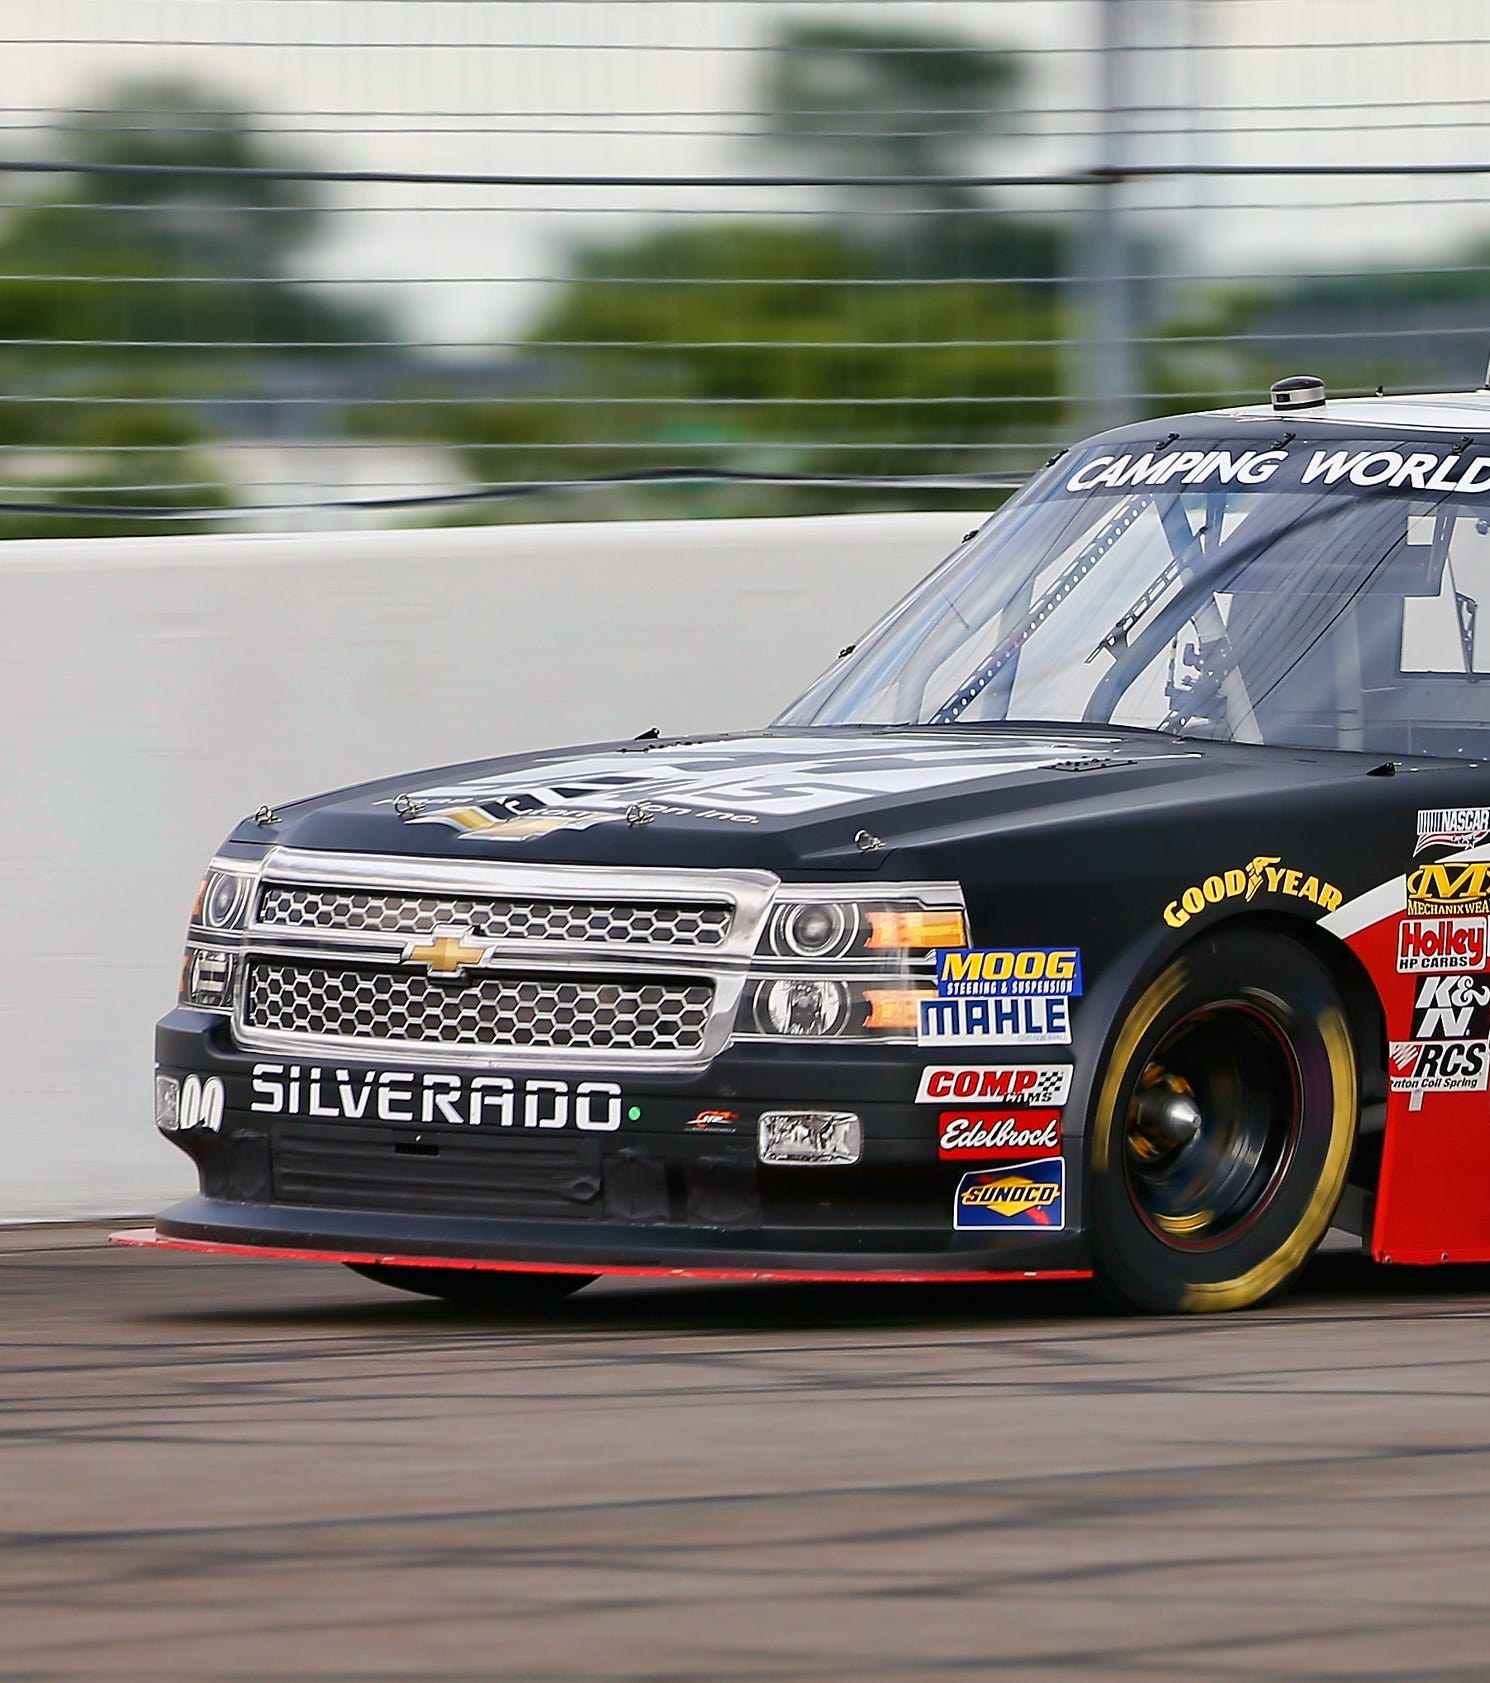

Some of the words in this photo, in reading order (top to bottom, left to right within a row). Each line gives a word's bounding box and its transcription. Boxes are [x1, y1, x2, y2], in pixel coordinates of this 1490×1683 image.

[1065, 450, 1287, 492] CAMPING
[1440, 809, 1490, 833] NASCAR
[1163, 856, 1344, 928] GOODYEAR
[1407, 899, 1464, 916] MECHANIX
[1401, 921, 1485, 966] Holley
[941, 951, 1077, 981] MOOG
[1399, 957, 1418, 970] HP
[1420, 955, 1468, 968] CARBS
[946, 981, 997, 995] STEERING
[1000, 981, 1008, 994] &
[1011, 979, 1073, 994] SUSPENSION
[921, 999, 1066, 1036] MAHLE
[1413, 1042, 1487, 1077] RCS
[250, 1064, 622, 1131] SILVERADO
[927, 1070, 1038, 1098] COMP
[1001, 1091, 1053, 1104] CAMS
[1421, 1078, 1441, 1088] Coil
[1443, 1077, 1478, 1089] Spring
[940, 1118, 1058, 1150] Edelbrock
[964, 1186, 1056, 1203] SUNOCO
